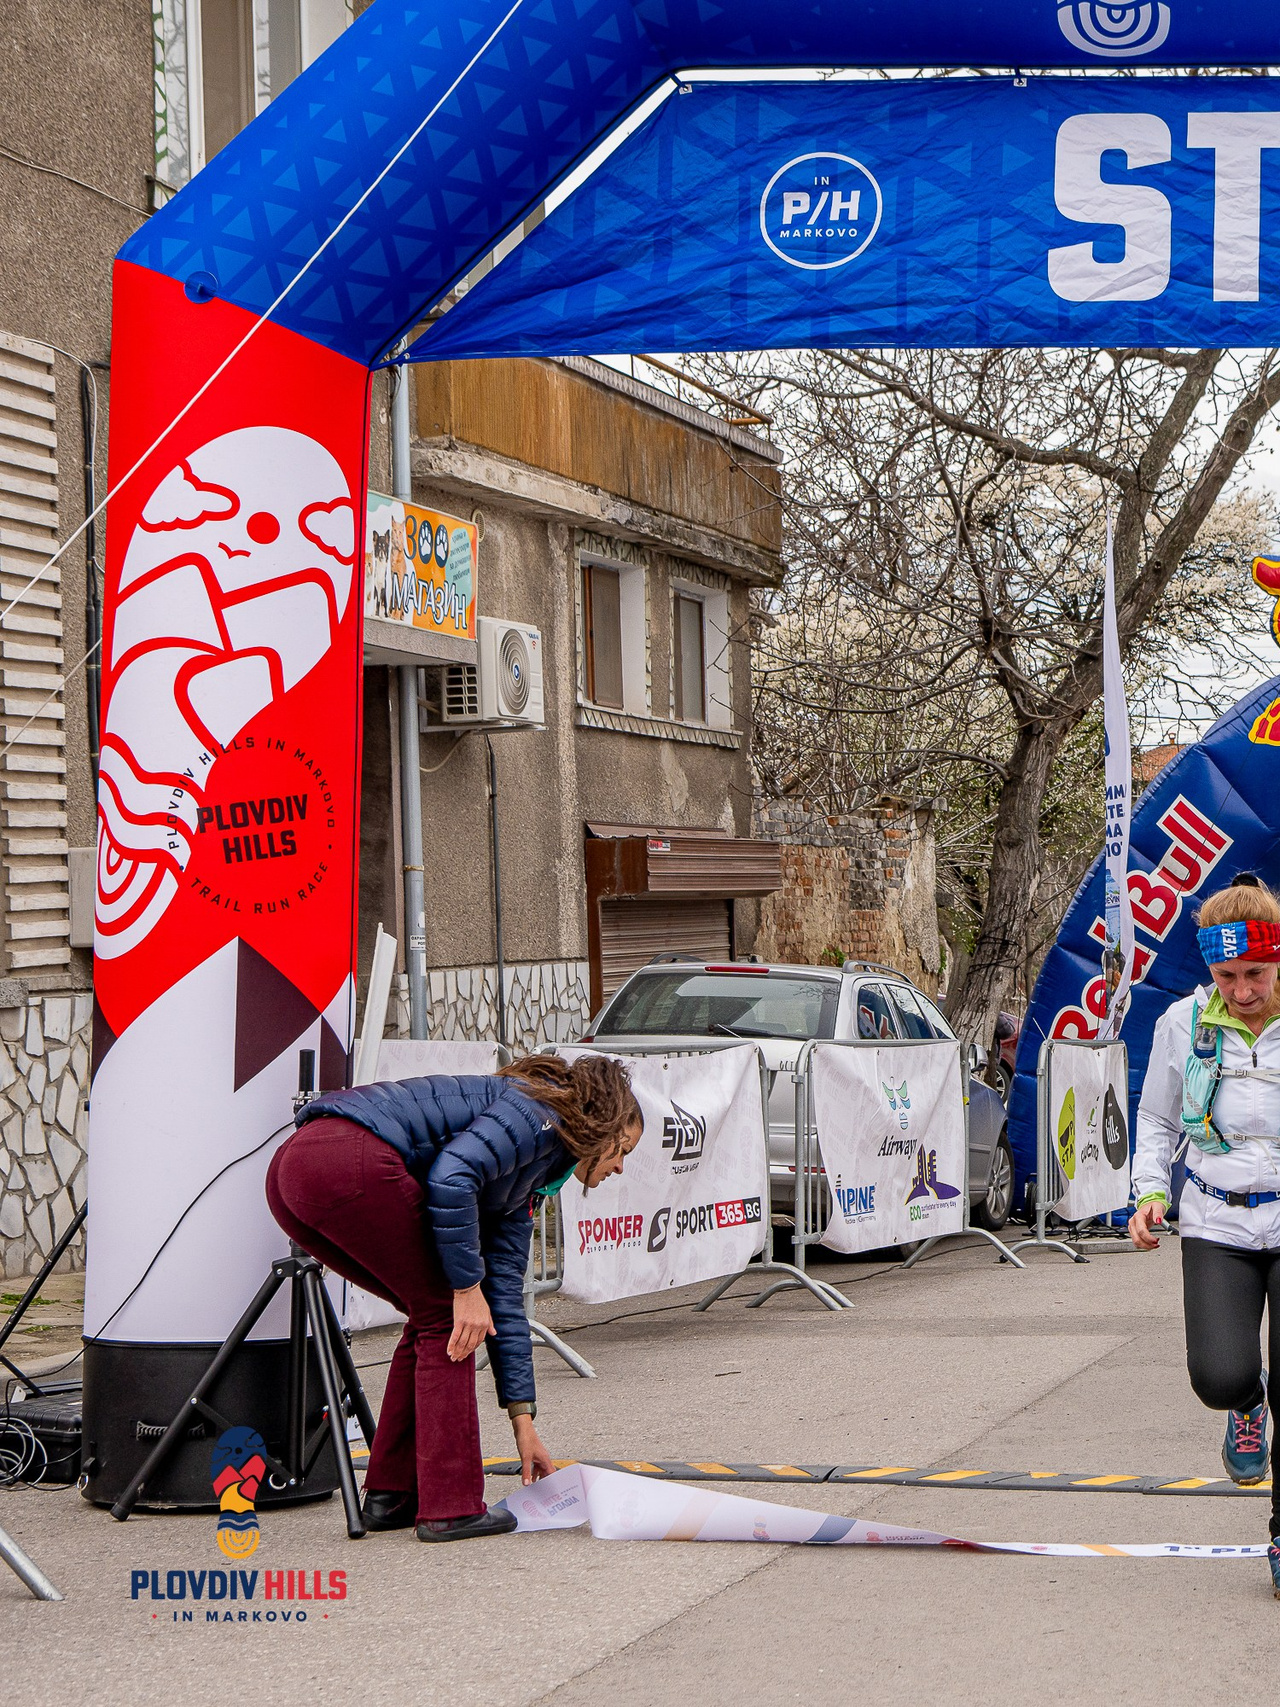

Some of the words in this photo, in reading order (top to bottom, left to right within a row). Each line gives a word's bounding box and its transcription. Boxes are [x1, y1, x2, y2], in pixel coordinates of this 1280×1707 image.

[814, 176, 829, 185] IN
[782, 190, 860, 225] P/H
[780, 228, 857, 237] MARKOVO
[391, 571, 468, 629] МАГАЗИН
[167, 767, 195, 850] PLOVDIV
[199, 737, 255, 765] HILLS
[267, 738, 285, 751] IN
[293, 748, 335, 828] MARKOVO
[196, 794, 307, 834] PLOVDIV
[222, 830, 297, 864] HILLS
[191, 877, 241, 912] TRAIL
[254, 898, 290, 914] RUN
[297, 861, 328, 900] RACE
[1122, 797, 1230, 938] Bull
[578, 1215, 643, 1255] SPONSER
